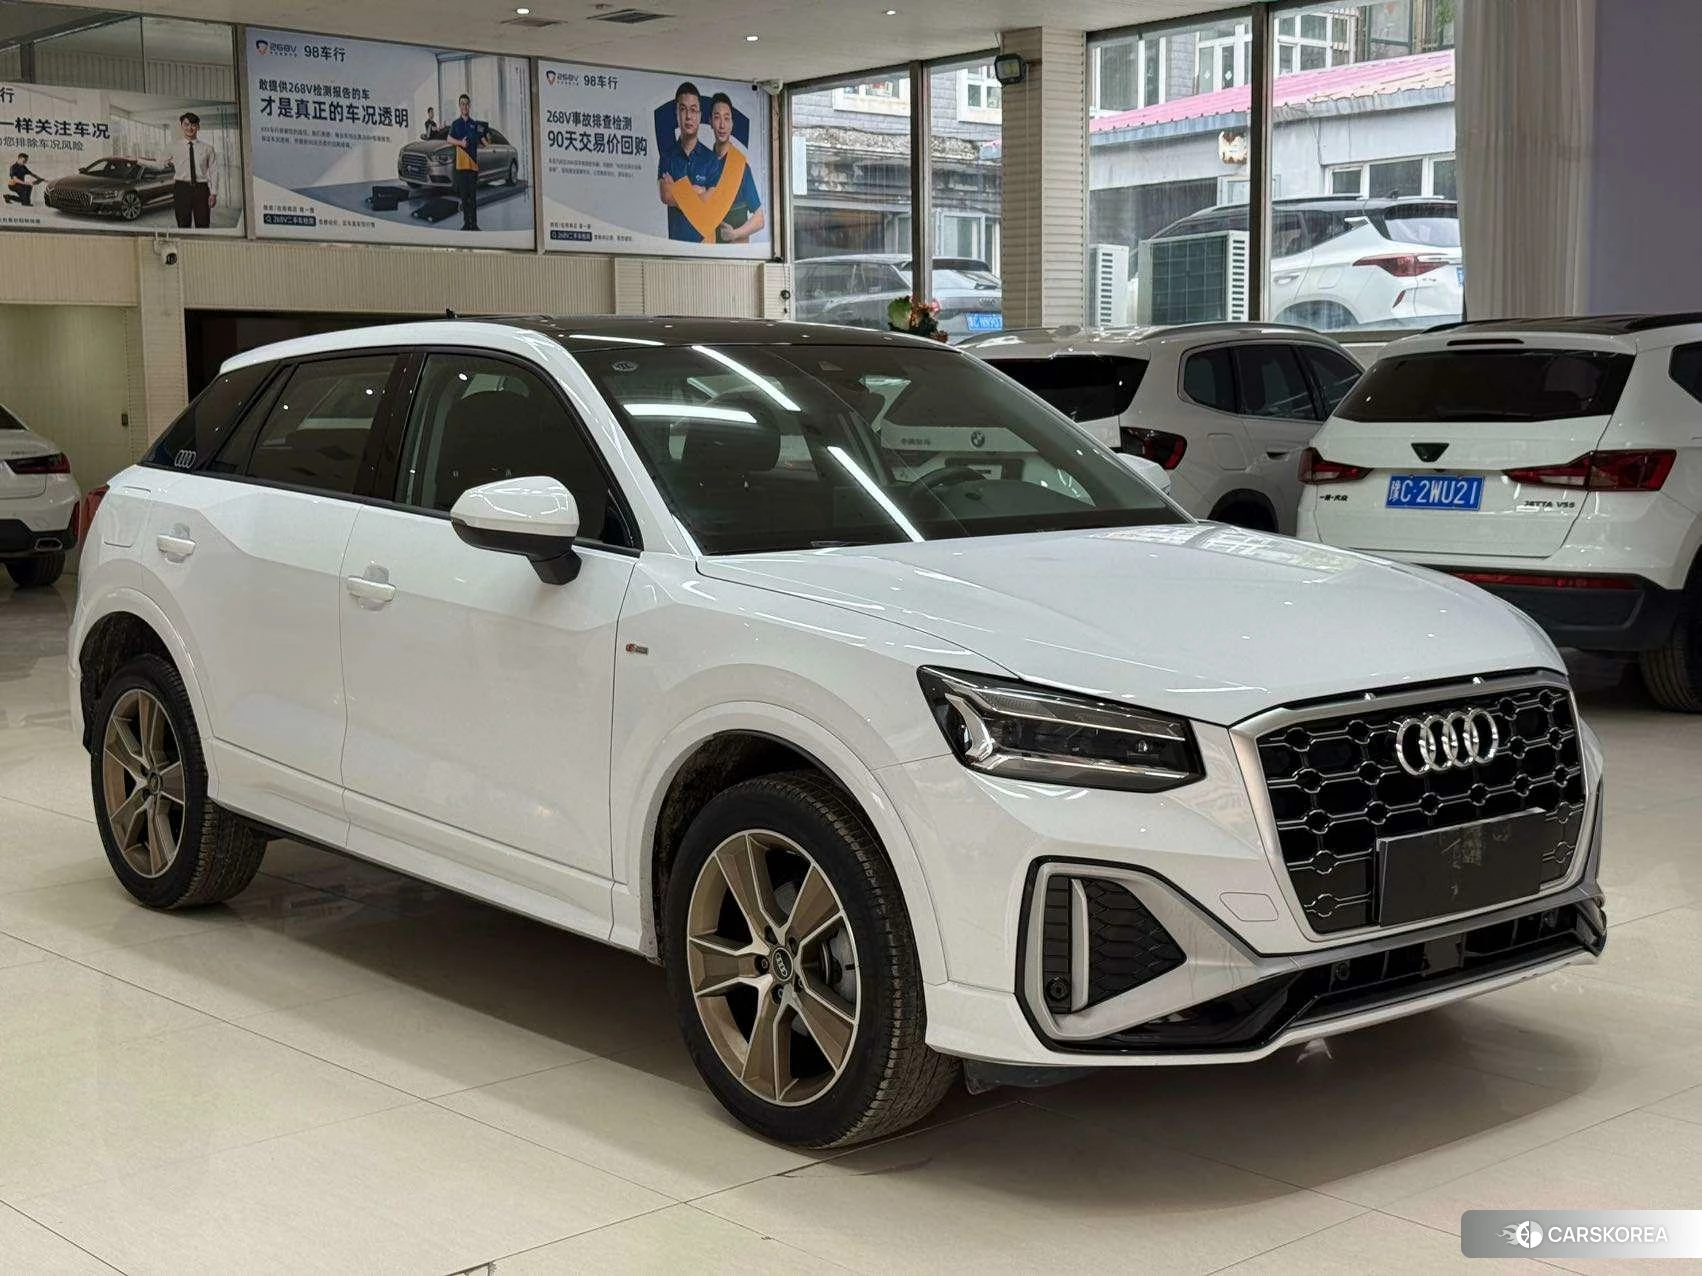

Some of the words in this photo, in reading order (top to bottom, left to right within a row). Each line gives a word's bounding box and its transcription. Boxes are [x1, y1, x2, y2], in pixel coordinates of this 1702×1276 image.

[304, 45, 346, 63] 98车行
[258, 78, 371, 101] 敢提供268V检测报告的车
[583, 75, 618, 90] 98车行
[260, 95, 409, 128] 才是真正的车况透明
[546, 109, 632, 131] 268V事故排查检测
[0, 117, 111, 139] 一样关注车况
[0, 136, 84, 152] 您排除车况风险
[547, 130, 648, 156] 90天交易价回购
